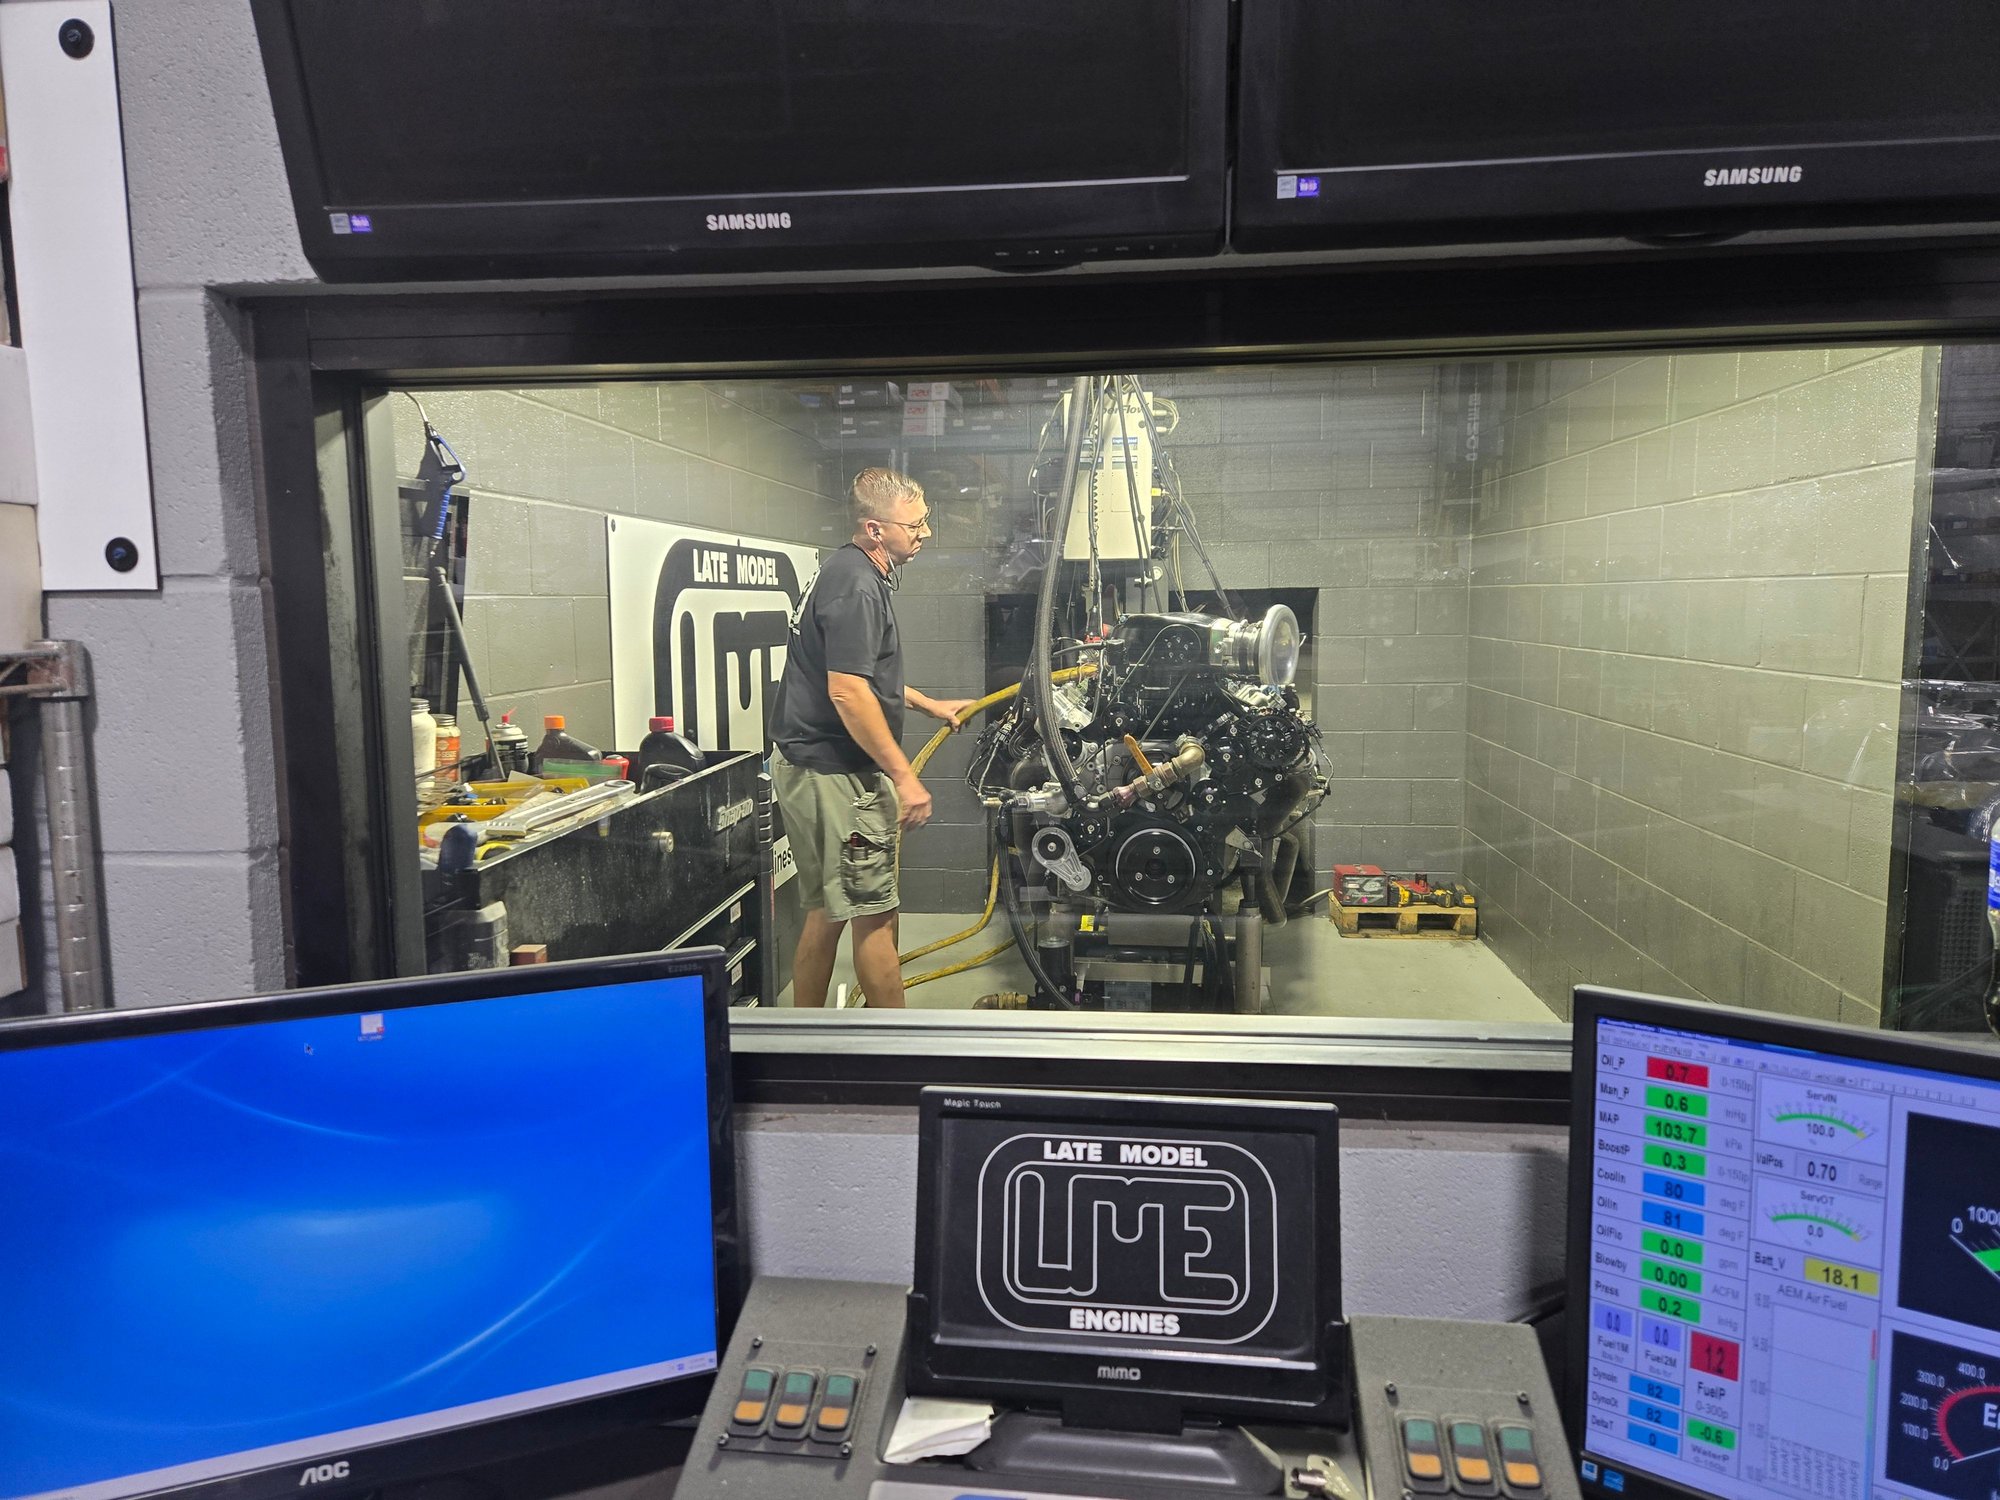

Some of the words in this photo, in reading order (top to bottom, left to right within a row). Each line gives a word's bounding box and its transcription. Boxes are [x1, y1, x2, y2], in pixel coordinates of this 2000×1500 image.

[1703, 165, 1803, 187] SAMSUNG
[705, 212, 792, 231] SAMSUNG
[692, 548, 729, 584] LATE
[736, 553, 779, 586] MODEL
[1665, 1064, 1690, 1082] 0.7
[943, 1097, 971, 1109] Magic
[973, 1098, 1002, 1109] Touch
[1664, 1093, 1689, 1112] 0.6
[1599, 1112, 1620, 1124] MAP
[1655, 1120, 1698, 1144] 103.7
[1807, 1122, 1836, 1139] 100.0
[1043, 1141, 1103, 1162] LATE
[1119, 1144, 1209, 1167] MODEL
[1662, 1151, 1687, 1171] 0.3
[1807, 1160, 1838, 1182] 0.70
[1664, 1181, 1684, 1200] 80
[1663, 1210, 1682, 1230] 81
[1951, 1217, 1964, 1234] 0
[1967, 1205, 2000, 1228] 100
[1806, 1224, 1825, 1239] 0.0
[1660, 1239, 1684, 1259] 0.0
[1595, 1252, 1628, 1272] Blowby
[1754, 1251, 1787, 1271] Batt_V
[1654, 1266, 1688, 1289] 0.00
[1822, 1266, 1860, 1290] 18.1
[1595, 1280, 1620, 1297] Press
[1778, 1284, 1803, 1300] AEM
[1658, 1296, 1682, 1318] 0.2
[1069, 1308, 1181, 1336] ENGINES
[1606, 1311, 1622, 1333] 0.0
[1654, 1325, 1670, 1347] 0.0
[1097, 1366, 1142, 1381] mimo
[1647, 1382, 1664, 1400] 82
[1698, 1381, 1727, 1400] FuelP
[1646, 1407, 1662, 1425] 82
[1648, 1432, 1657, 1447] 0
[1700, 1426, 1723, 1445] -0.6
[298, 1460, 351, 1487] AOC
[1932, 1456, 1950, 1472] 0.0
